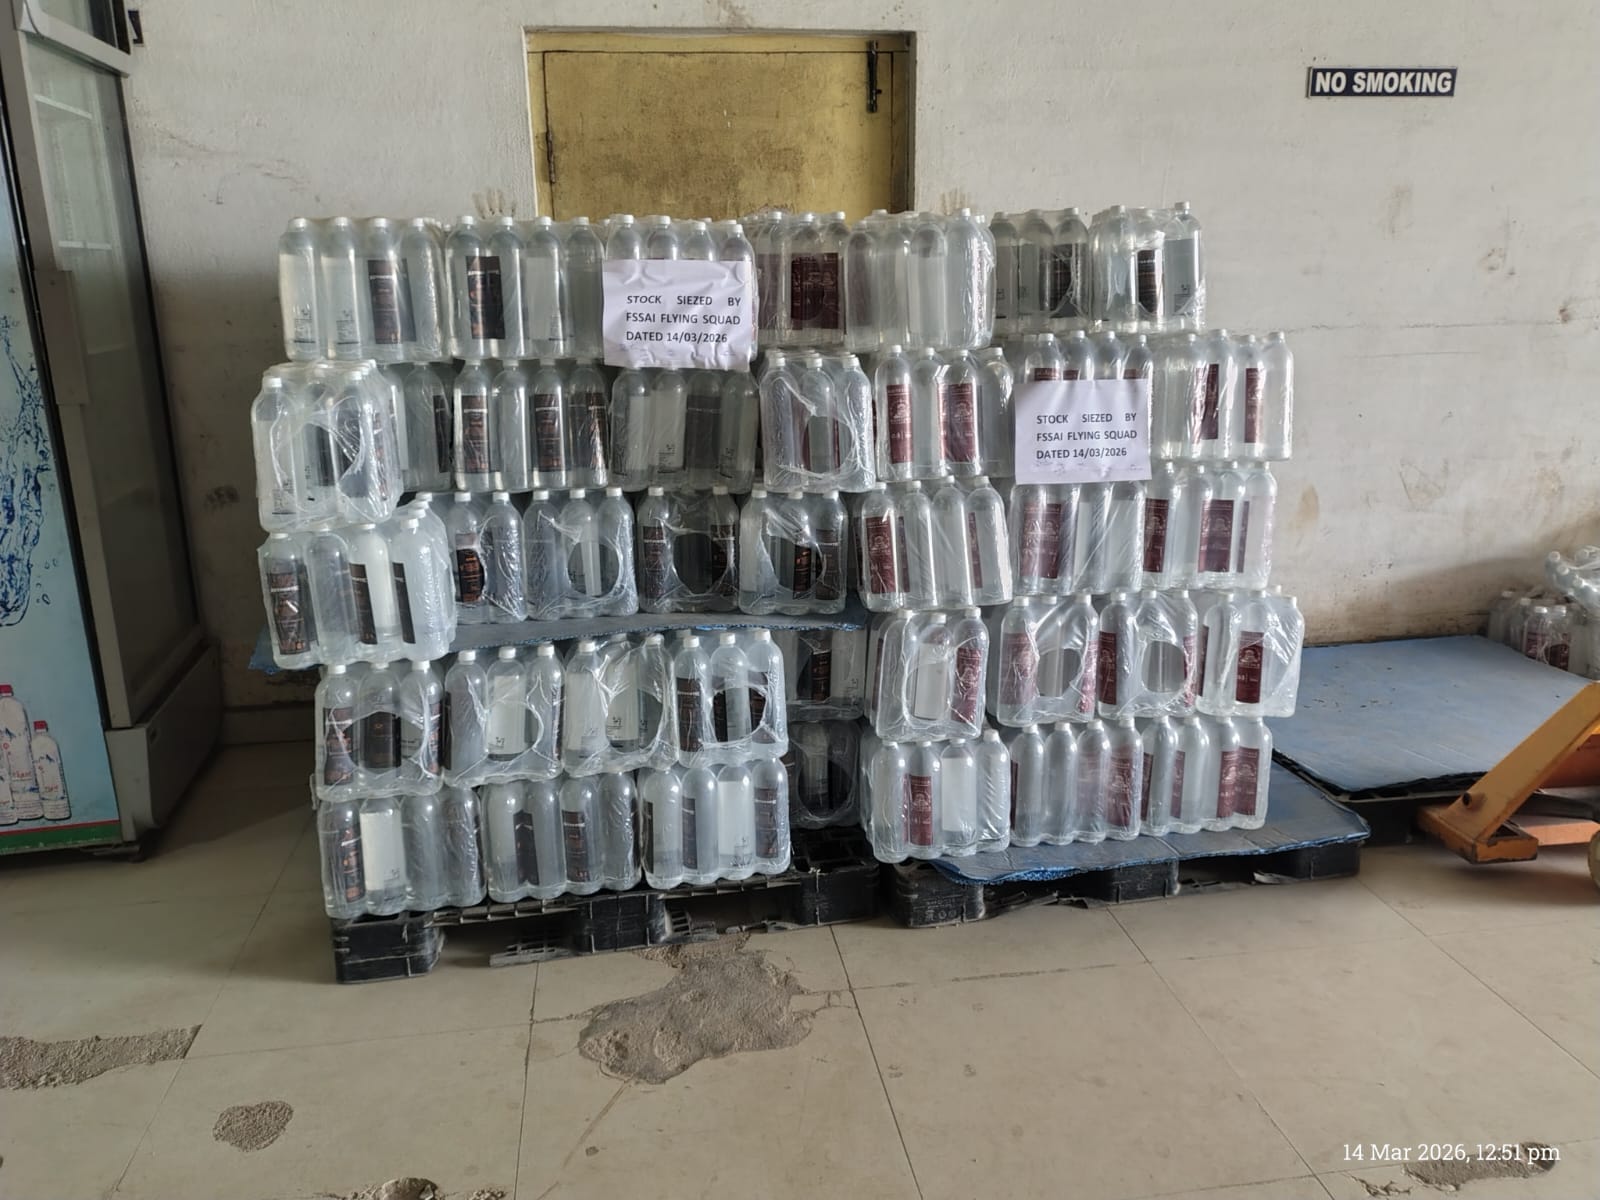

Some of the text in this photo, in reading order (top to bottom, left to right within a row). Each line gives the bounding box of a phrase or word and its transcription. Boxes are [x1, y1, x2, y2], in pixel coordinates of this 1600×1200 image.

[1315, 71, 1453, 93] NO SMOKING
[626, 295, 741, 307] STOCK SIEZED BY
[626, 312, 741, 326] FSSAI FLYING SQUAD
[626, 331, 728, 344] DATED 14/03/2026
[1036, 412, 1137, 425] STOCK SIEZED BY
[1036, 430, 1137, 442] FSSAI FLYING SQUAD
[1036, 447, 1127, 460] DATED 14/03/2026
